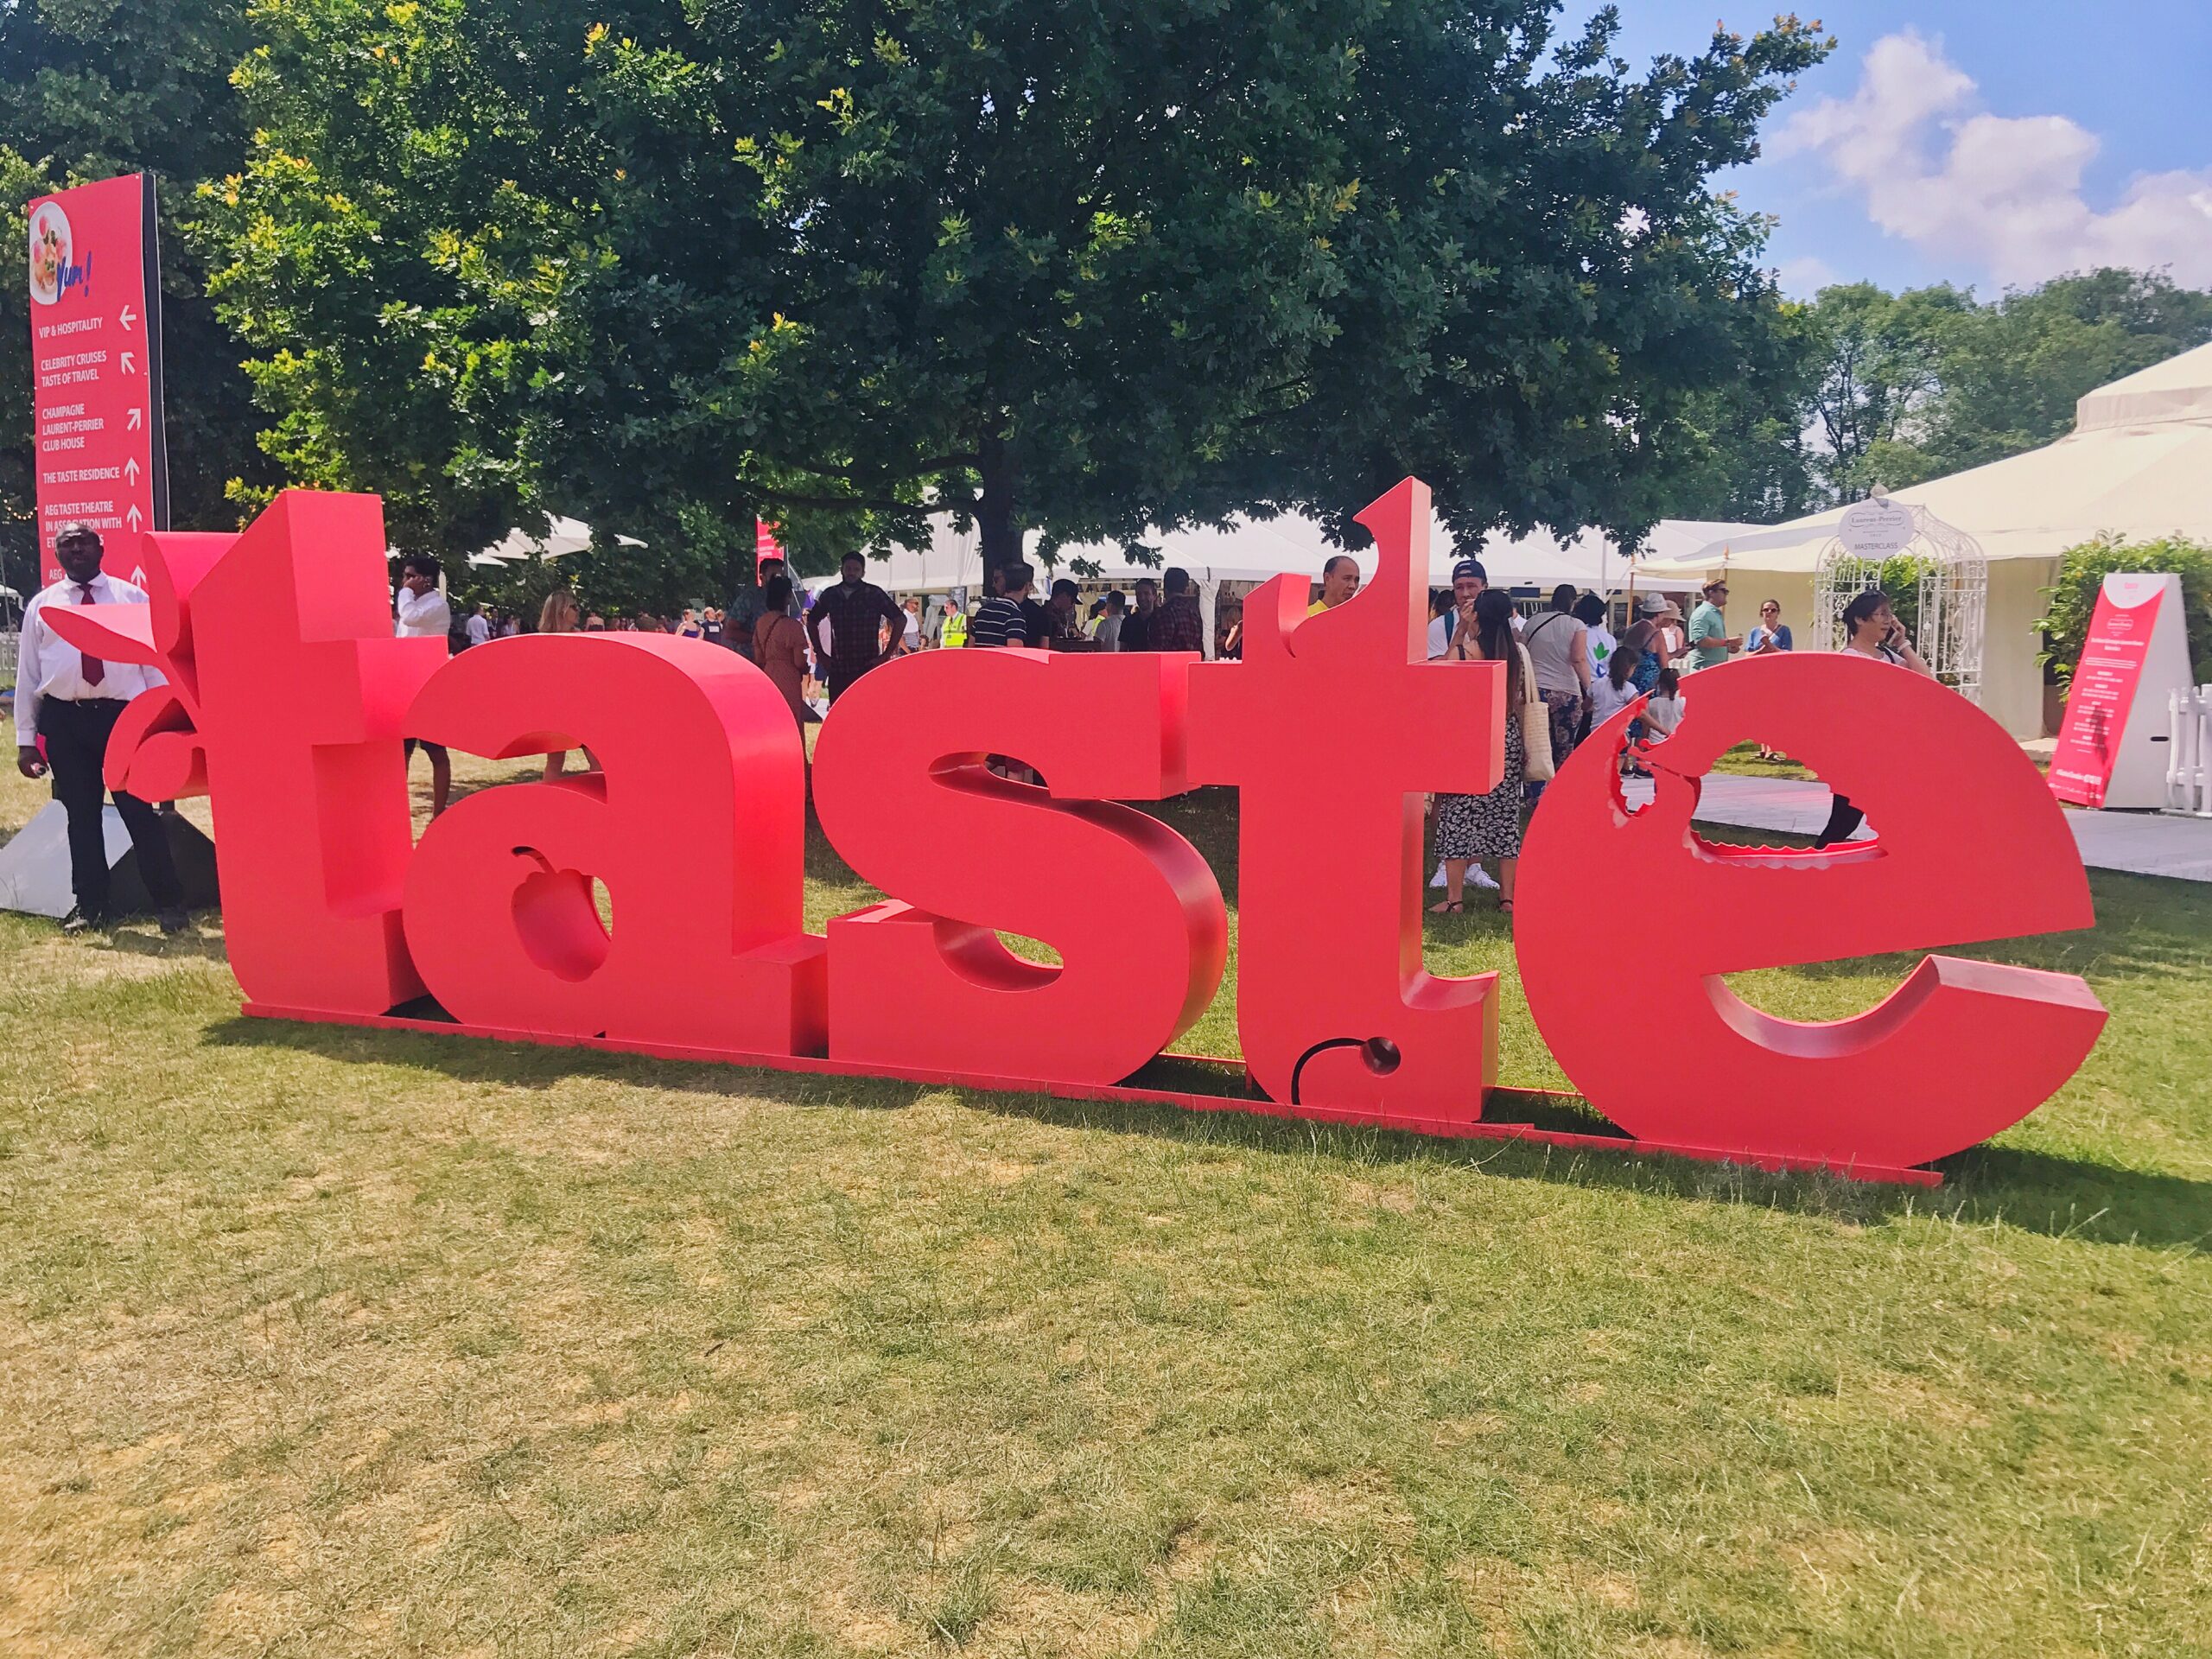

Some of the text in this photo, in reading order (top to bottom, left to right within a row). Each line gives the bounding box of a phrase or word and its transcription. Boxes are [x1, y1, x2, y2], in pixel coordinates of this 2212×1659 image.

[57, 251, 92, 302] Yum!
[39, 327, 50, 339] VIP
[57, 317, 103, 335] HOSPITALITY
[41, 350, 106, 371] CELEBRITY CRUISES
[41, 368, 99, 387] TASTE OF TRAVEL
[42, 404, 85, 419] CHAMPAGNE
[42, 418, 104, 435] LAURENT-PERRIER
[42, 436, 85, 451] CLUB HOUSE
[43, 467, 120, 484] THE TASTE RESIDENCE
[45, 501, 113, 516] AEG TASTE THEATRE
[45, 521, 53, 532] IN
[101, 517, 122, 529] WITH
[1854, 542, 1898, 550] MASTERCLASS
[49, 569, 63, 580] AEG
[40, 477, 2107, 1184] taste
